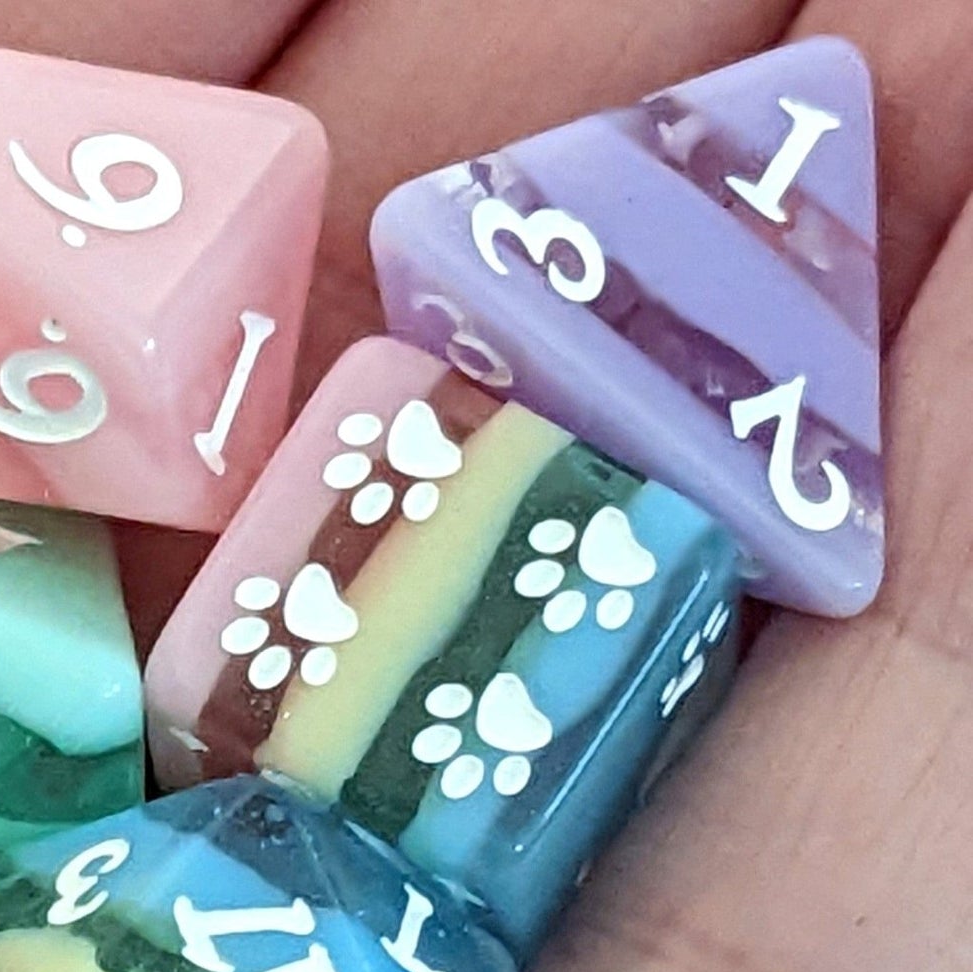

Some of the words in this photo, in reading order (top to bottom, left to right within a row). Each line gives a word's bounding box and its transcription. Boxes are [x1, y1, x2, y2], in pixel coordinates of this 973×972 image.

[726, 96, 841, 223] 1
[471, 197, 606, 303] 3
[193, 309, 276, 476] 1
